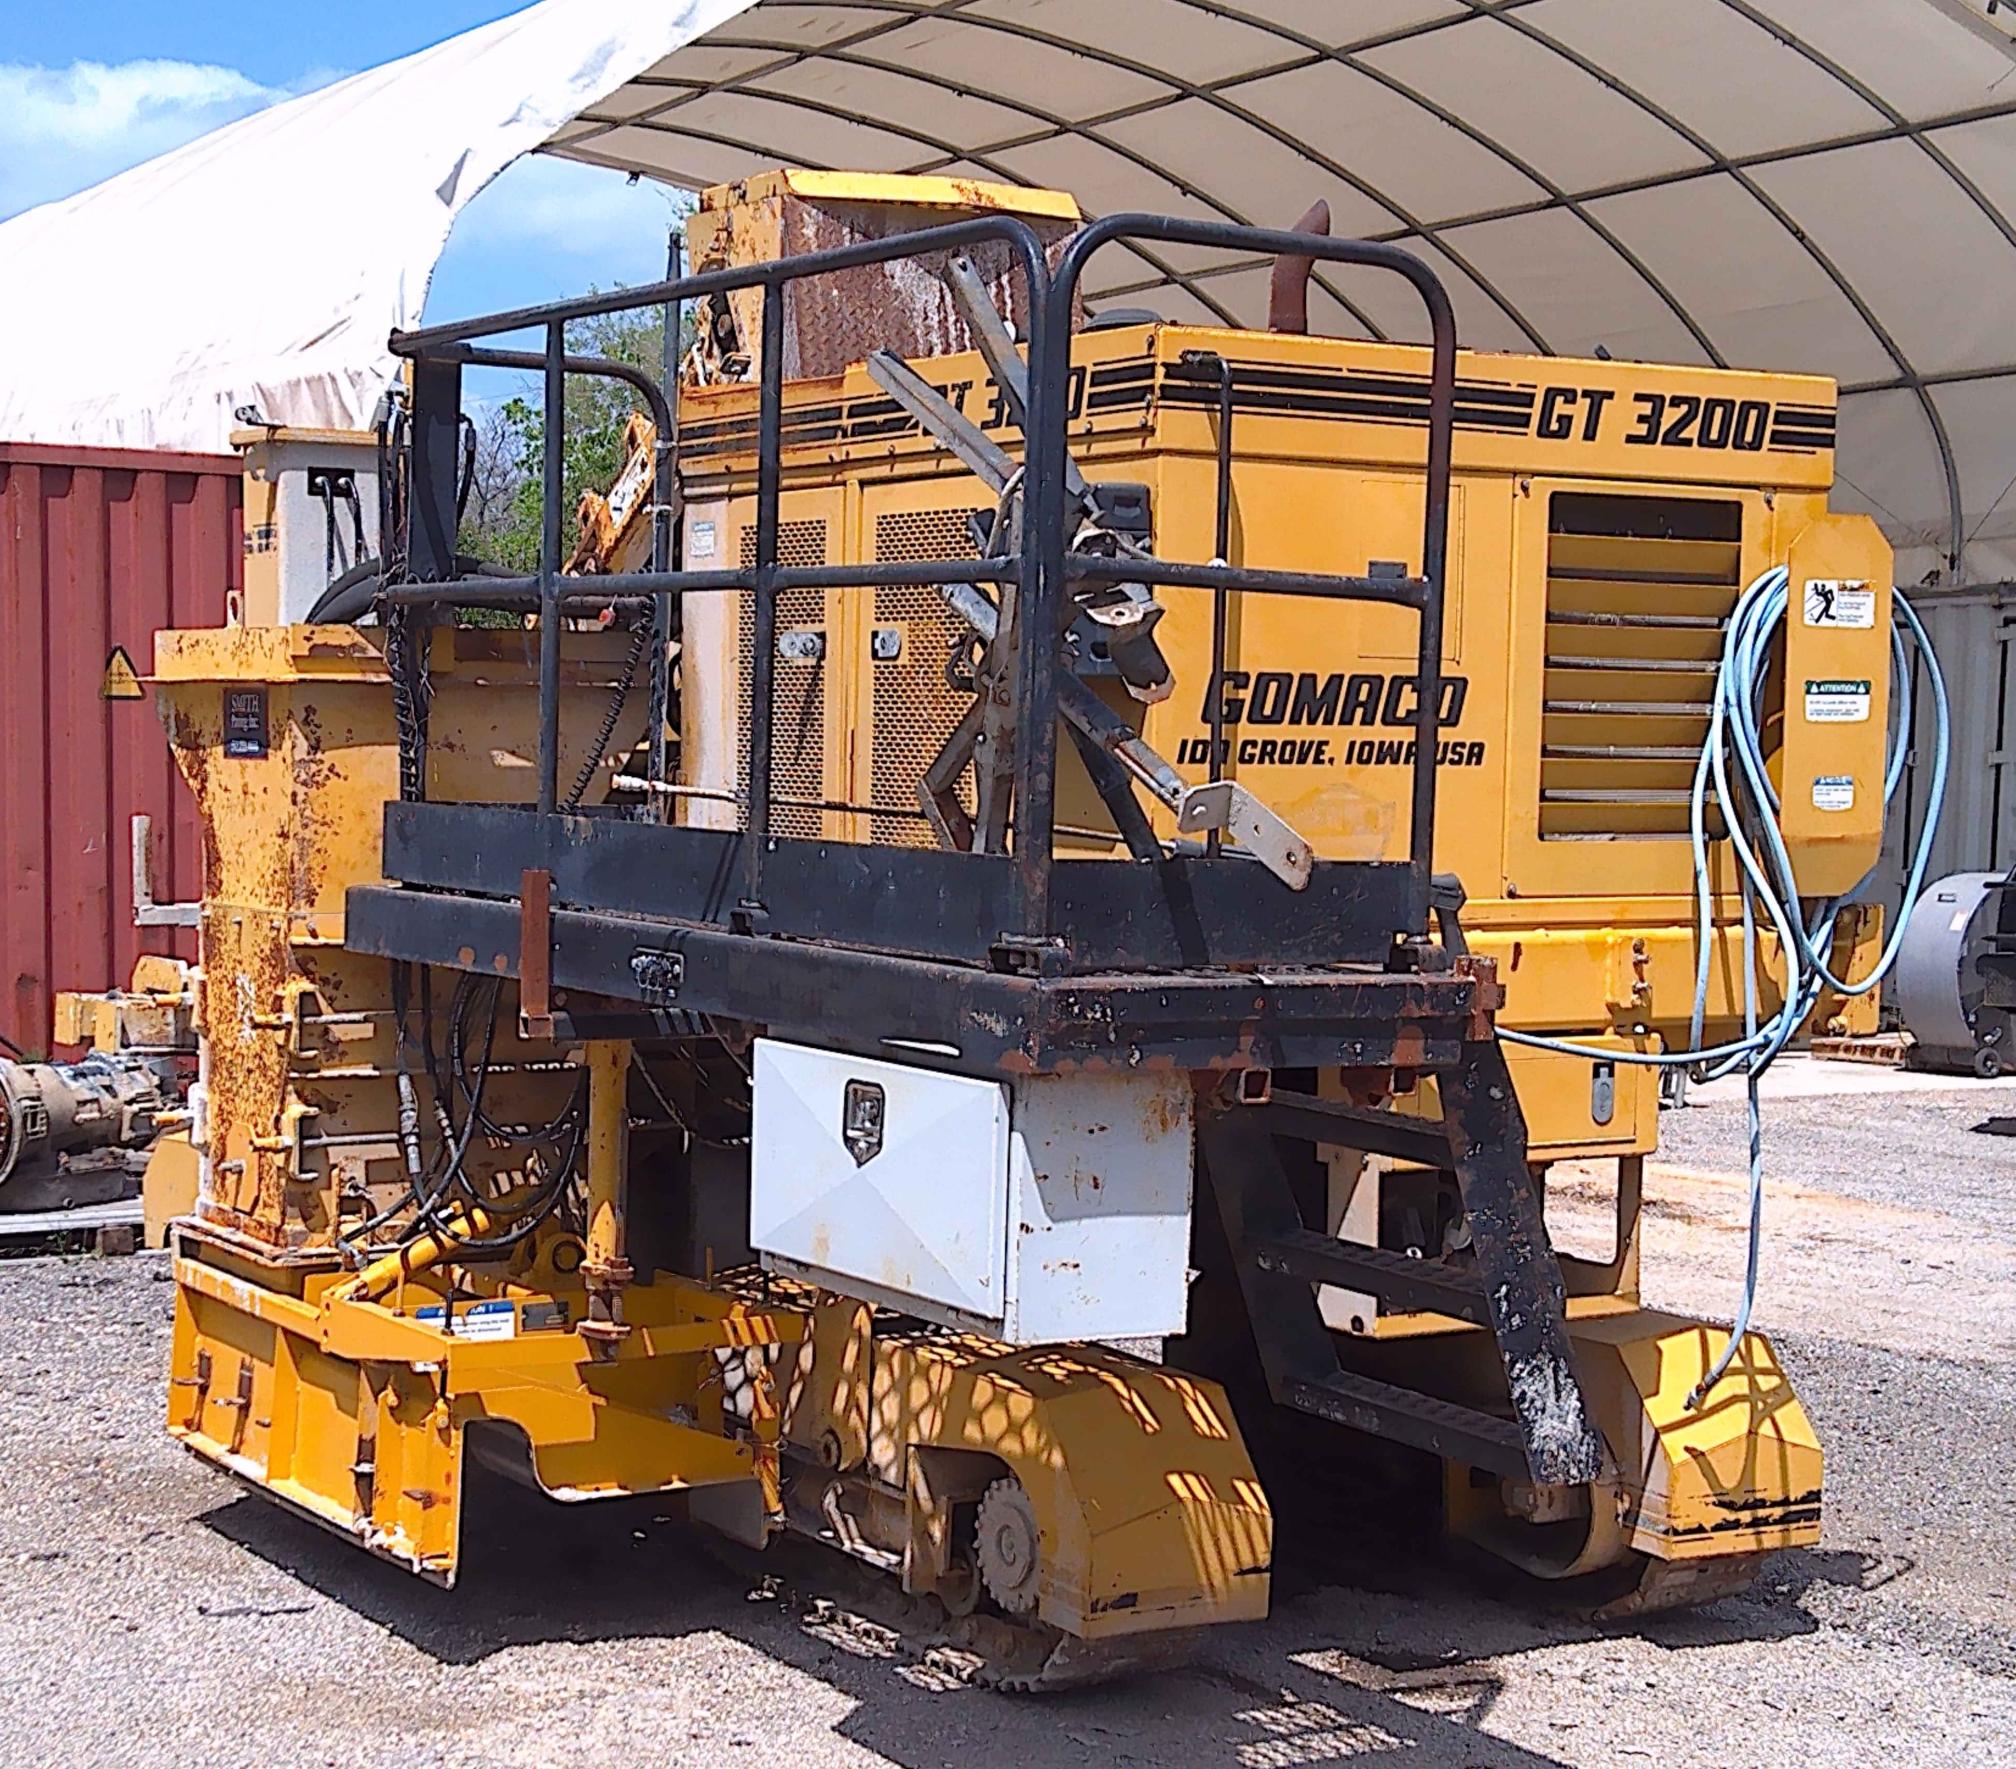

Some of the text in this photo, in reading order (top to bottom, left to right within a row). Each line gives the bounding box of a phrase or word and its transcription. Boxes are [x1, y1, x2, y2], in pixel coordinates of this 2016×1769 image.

[981, 366, 1087, 430] 30
[1536, 386, 1771, 451] GT 3200
[1201, 671, 1468, 727] GOMACO
[1820, 684, 1857, 693] ATTENTION
[1238, 739, 1334, 766] GROVE,
